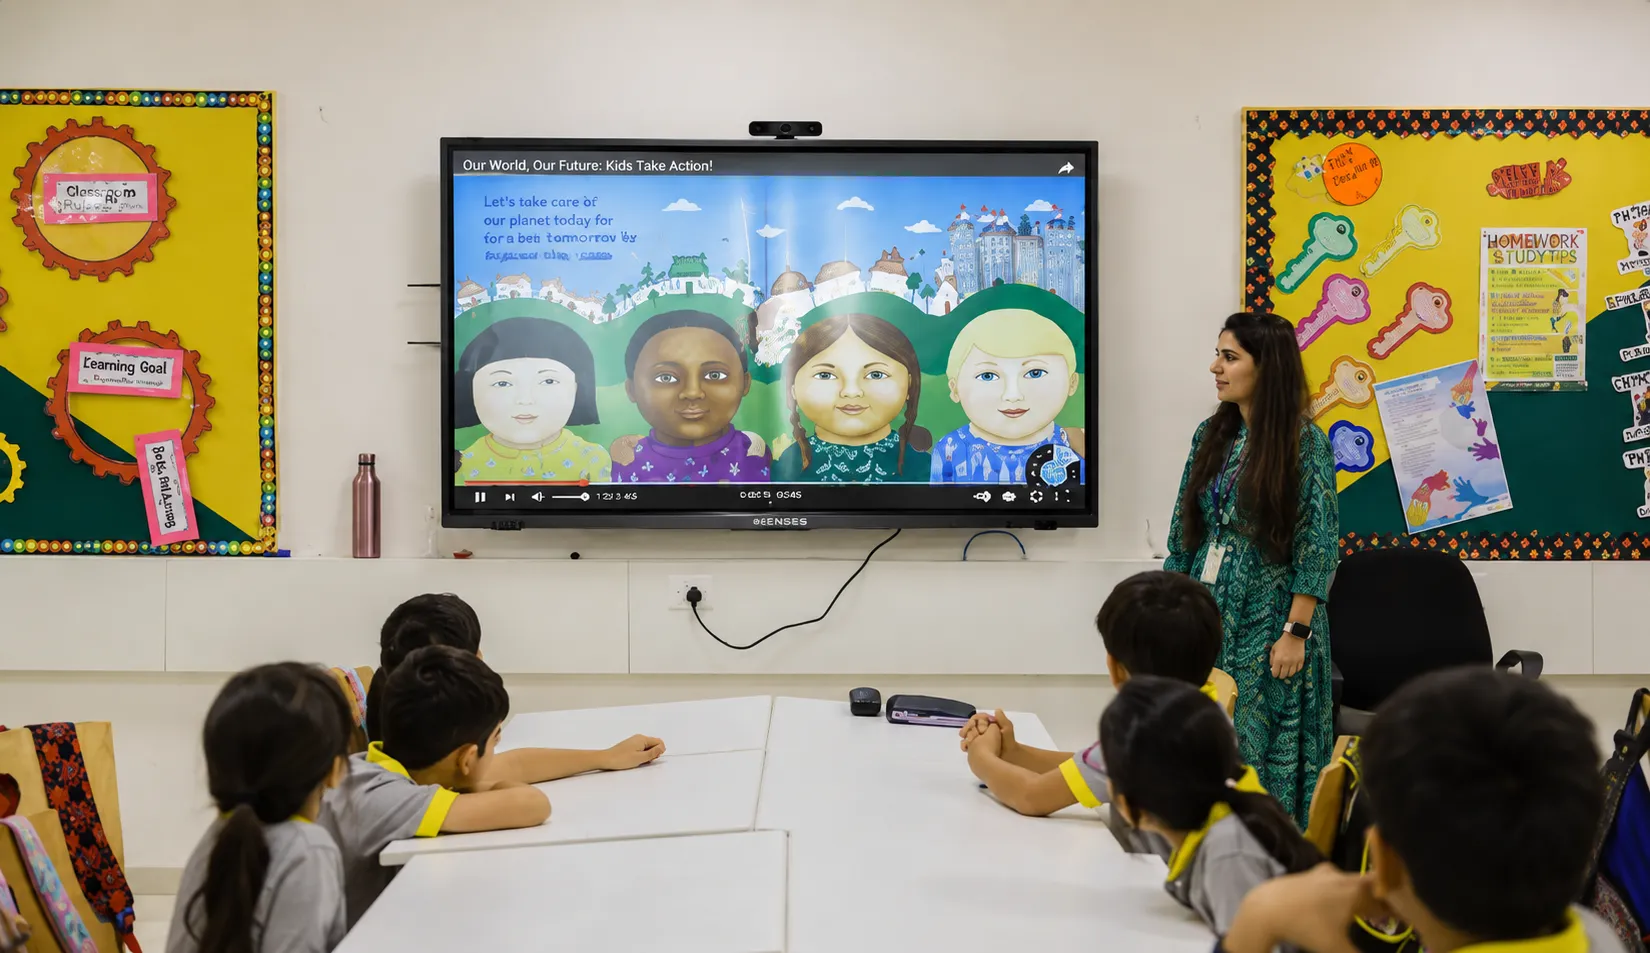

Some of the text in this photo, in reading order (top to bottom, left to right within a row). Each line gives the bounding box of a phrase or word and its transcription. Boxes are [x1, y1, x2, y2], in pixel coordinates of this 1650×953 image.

[463, 159, 713, 174] Our World, Our Future: Kids Take Action!
[484, 195, 516, 208] Let's
[519, 195, 548, 208] take
[551, 197, 580, 208] care
[483, 213, 614, 229] our planet today for
[483, 232, 506, 244] for
[1487, 233, 1580, 249] HOMEWORK
[83, 356, 168, 376] Learning Goal
